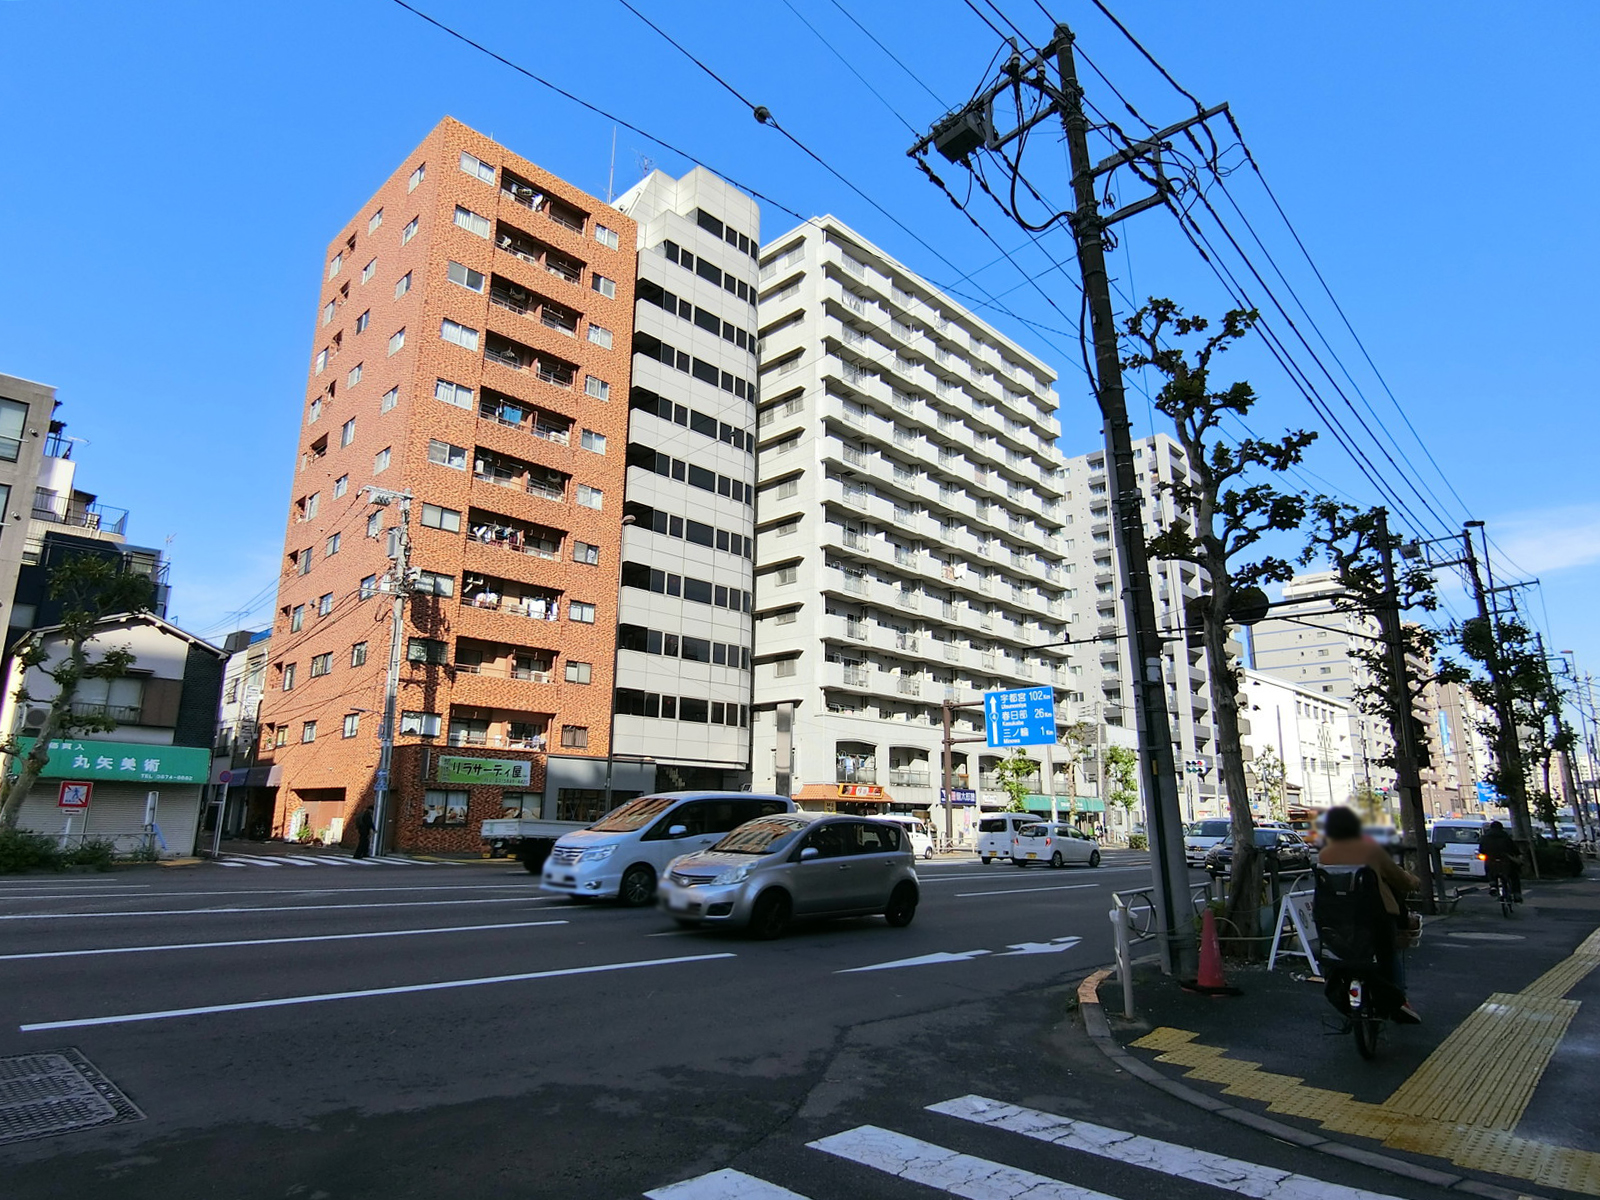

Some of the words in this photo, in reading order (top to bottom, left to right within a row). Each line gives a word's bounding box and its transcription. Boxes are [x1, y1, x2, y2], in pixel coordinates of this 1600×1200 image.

[1000, 693, 1026, 703] 宇都宮
[1002, 710, 1028, 720] 春日部
[1003, 727, 1029, 737] 三ノ輪
[73, 755, 160, 771] 丸矢美術
